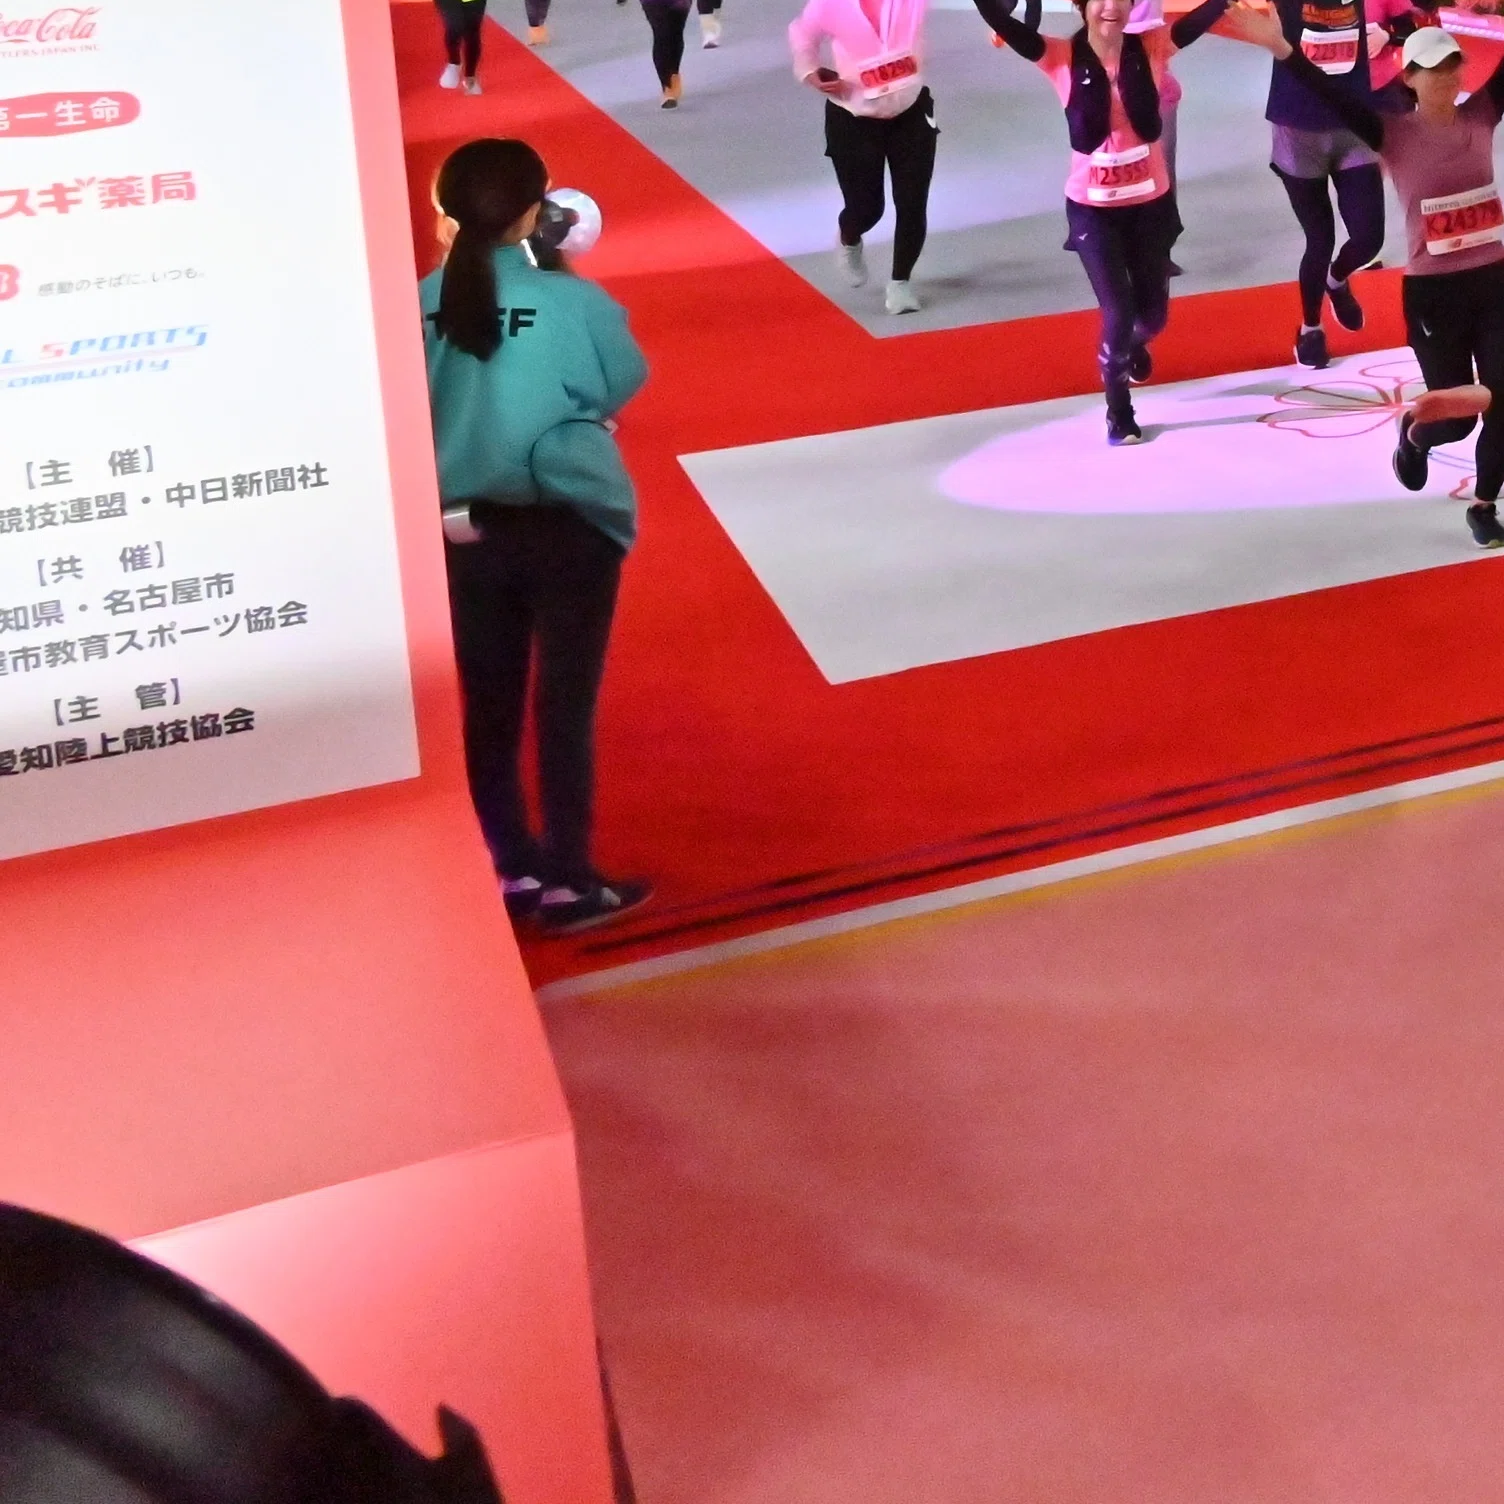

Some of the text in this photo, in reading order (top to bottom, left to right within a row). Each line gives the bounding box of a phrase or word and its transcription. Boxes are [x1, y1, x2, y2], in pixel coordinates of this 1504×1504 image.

[0, 170, 197, 220] スギ薬局
[0, 358, 171, 389] ommunity
[0, 600, 309, 677] 市教育スポーツ協会
